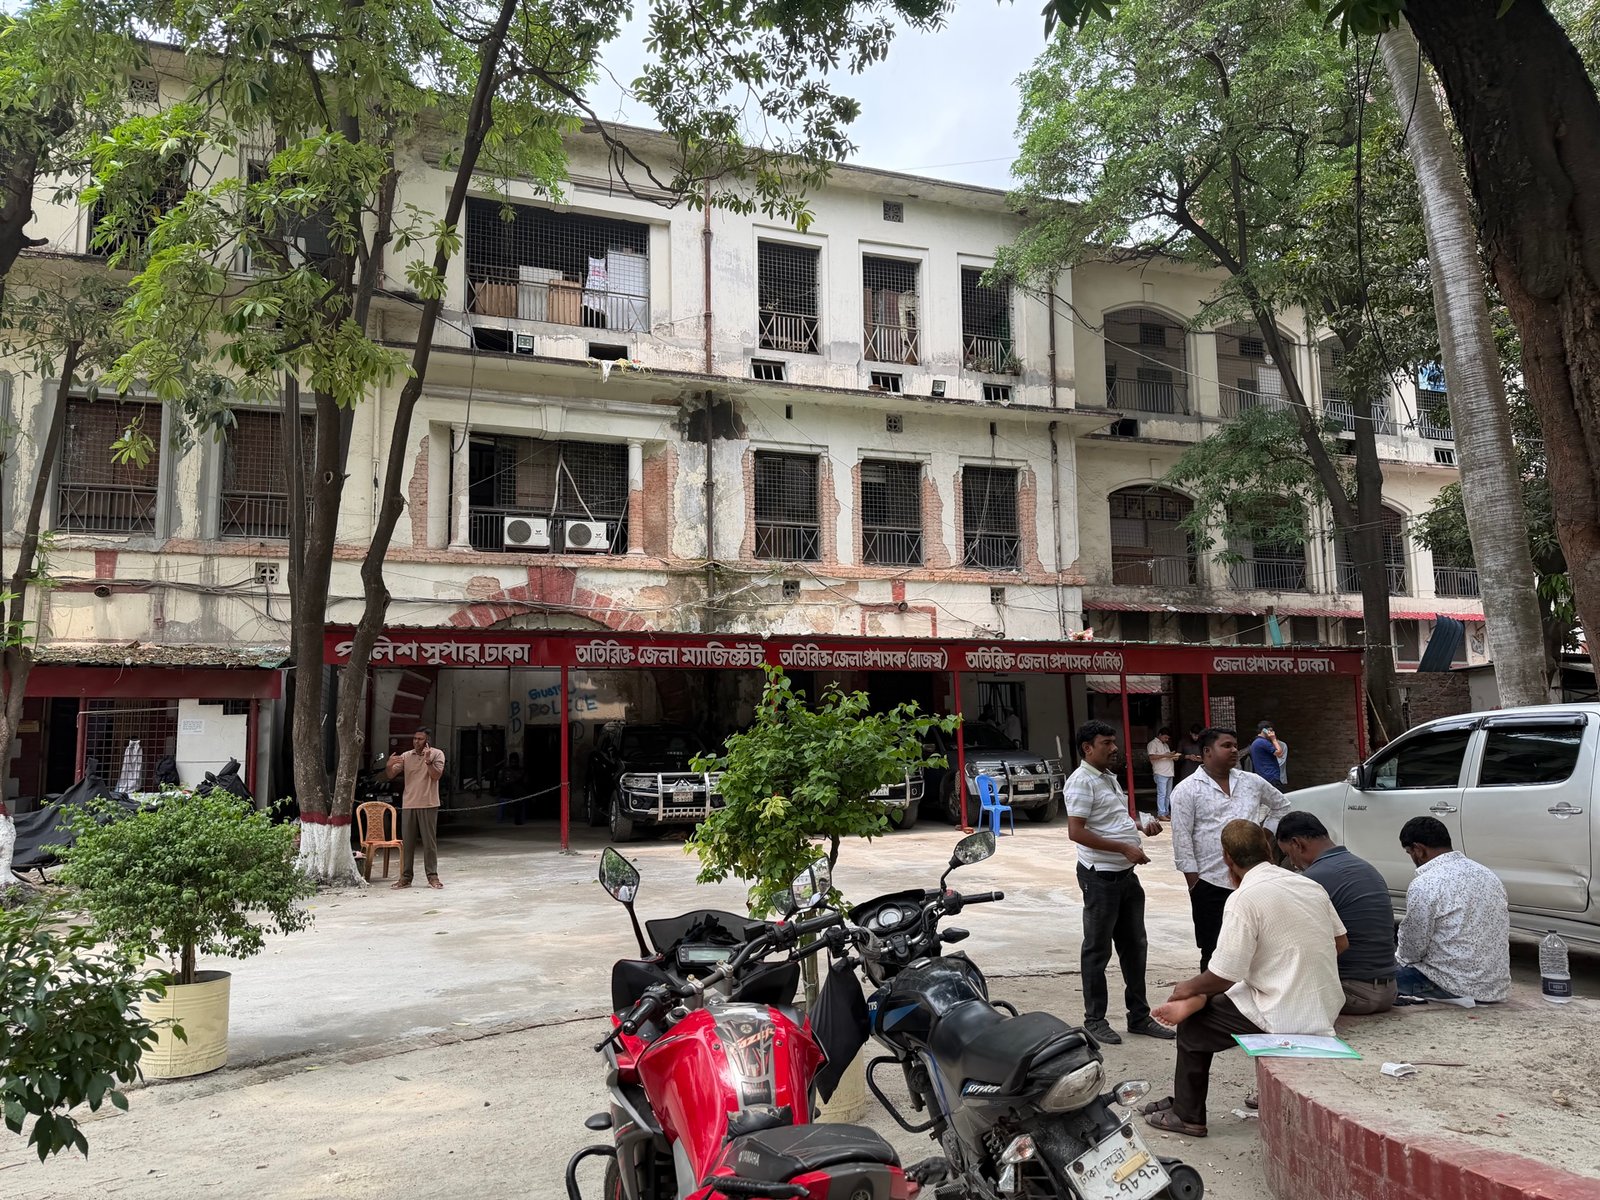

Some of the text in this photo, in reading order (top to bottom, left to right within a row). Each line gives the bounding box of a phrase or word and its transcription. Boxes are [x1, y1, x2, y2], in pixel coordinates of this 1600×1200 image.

[575, 639, 636, 664] অতিরিক্ত
[638, 645, 679, 665] জেলা
[779, 643, 949, 670] অতিরিক্ত জেলা প্রশাসক (রাজস্ব)
[965, 647, 1016, 670] অতিরিক্ত
[1017, 653, 1050, 671] জেলা
[1050, 651, 1092, 671] প্রশাসক
[1213, 656, 1247, 672] জেলা
[1080, 1165, 1101, 1185] ঢাকা
